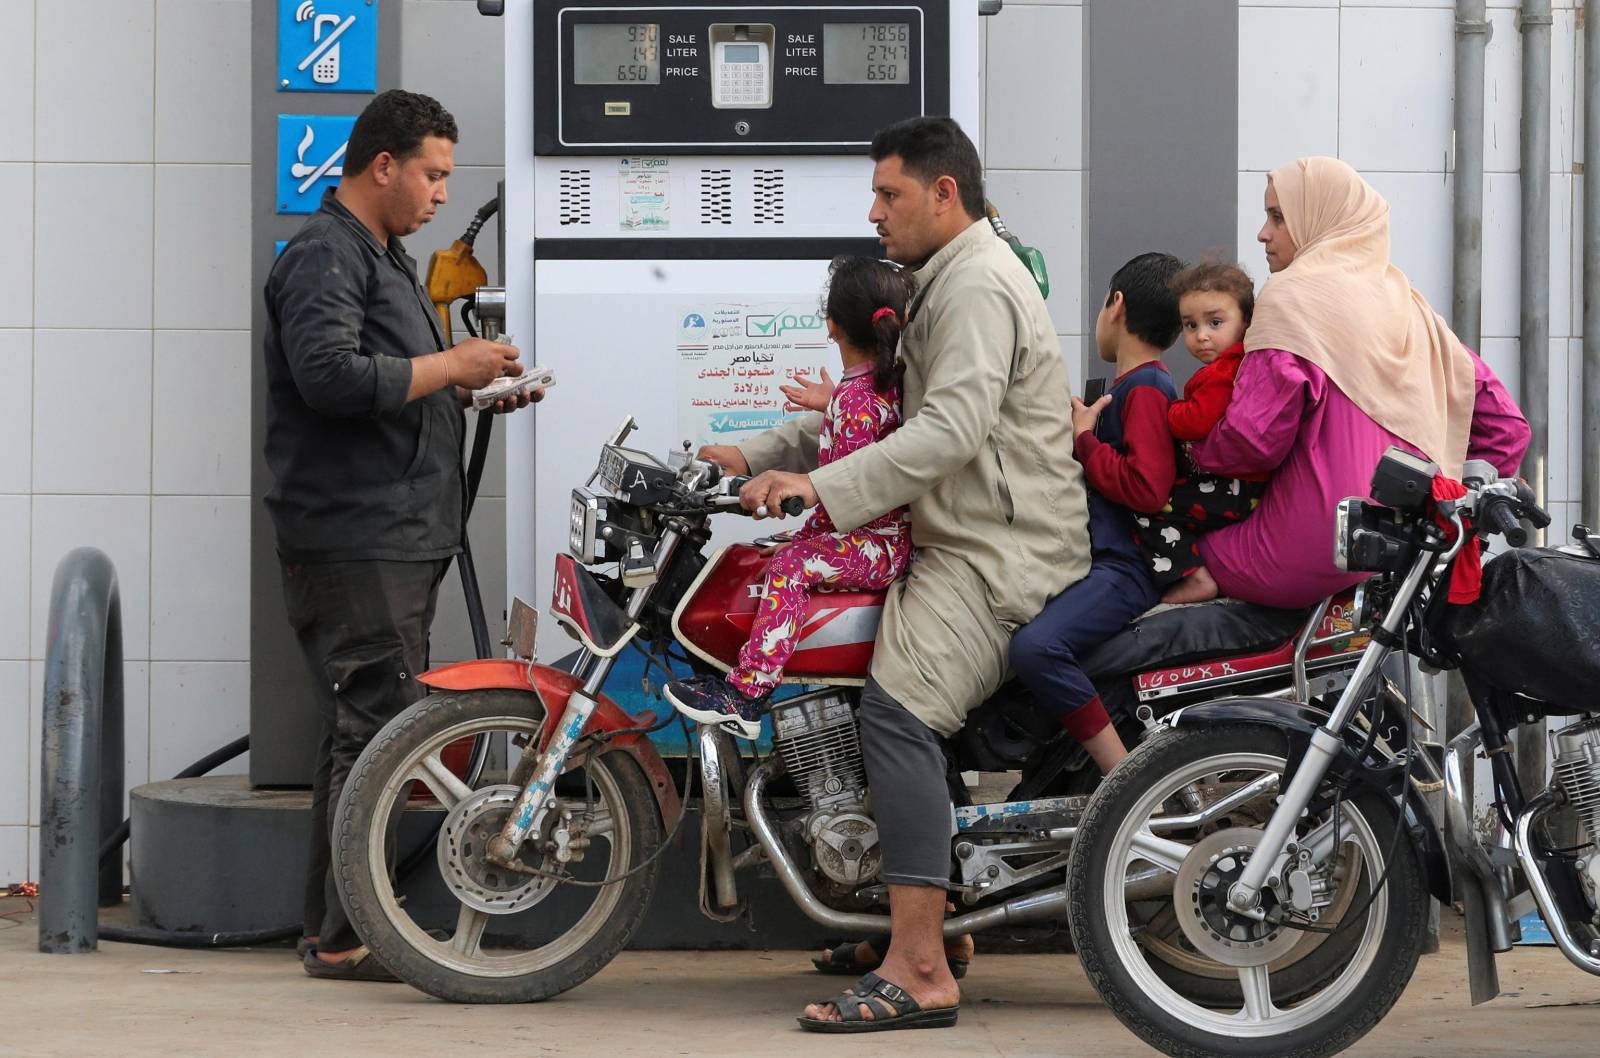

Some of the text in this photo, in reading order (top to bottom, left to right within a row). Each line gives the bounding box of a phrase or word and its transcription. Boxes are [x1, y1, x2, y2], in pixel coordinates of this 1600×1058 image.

[668, 34, 696, 44] SALE
[787, 34, 815, 44] SALE
[667, 48, 698, 57] LITER
[786, 48, 817, 57] LITER
[666, 67, 699, 77] PRICE
[785, 67, 818, 76] PRICE
[729, 351, 774, 366] تحيا مصر
[785, 366, 816, 379] الحاج
[723, 398, 752, 408] العاملين
[753, 399, 777, 408] وجميع
[629, 469, 648, 490] A
